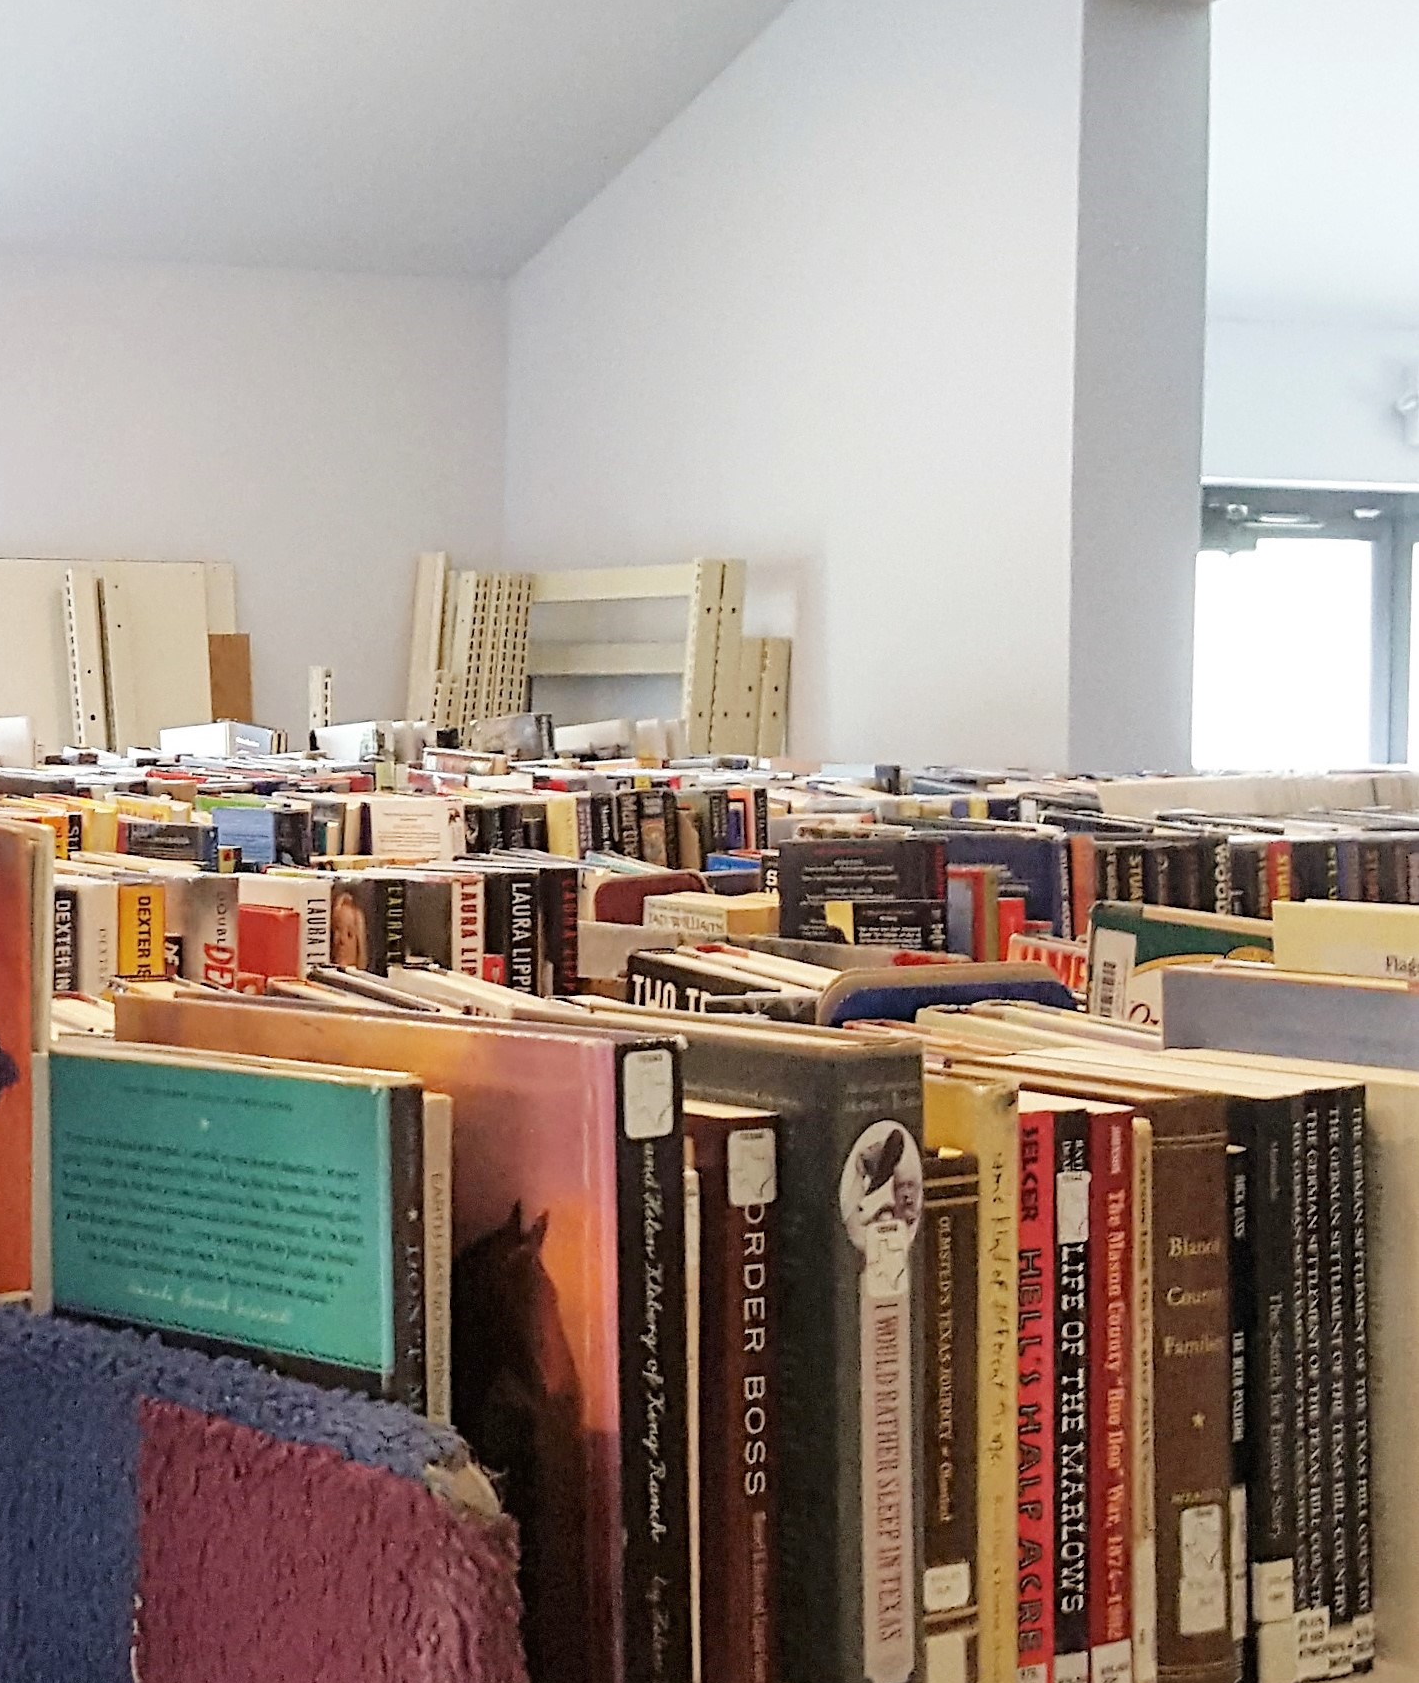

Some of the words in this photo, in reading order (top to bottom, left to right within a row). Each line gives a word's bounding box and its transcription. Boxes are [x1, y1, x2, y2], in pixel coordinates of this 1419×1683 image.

[1215, 843, 1232, 914] WOOD
[55, 899, 73, 973] DEXTER
[137, 895, 151, 959] DEXTER
[306, 898, 327, 946] LAURA
[385, 885, 404, 948] LAURA
[460, 881, 478, 948] LAURA
[511, 881, 532, 946] LAURA
[1306, 1108, 1318, 1144] THE
[1329, 1106, 1341, 1142] THE
[1352, 1105, 1364, 1141] THE
[1021, 1125, 1039, 1222] SELCER
[1307, 1147, 1319, 1230] GERMAN
[1330, 1145, 1342, 1227] GERMAN
[1353, 1144, 1365, 1225] GERMAN
[1108, 1188, 1127, 1228] The
[742, 1204, 765, 1354] ORDER
[1061, 1243, 1085, 1312] LIFE
[1107, 1230, 1126, 1299] Mason
[1307, 1233, 1320, 1351] SETTLEMENT
[1330, 1228, 1343, 1348] SETTLEMENT
[939, 1307, 954, 1363] TEXAS
[1018, 1247, 1043, 1384] HELL'S
[1061, 1320, 1086, 1357] OF
[1105, 1302, 1127, 1372] County
[1269, 1292, 1283, 1324] The
[640, 1358, 661, 1385] of
[875, 1316, 900, 1388] WOULD
[1309, 1353, 1321, 1379] OF
[1331, 1349, 1343, 1377] OF
[1355, 1346, 1367, 1373] OF
[645, 1386, 666, 1456] King
[939, 1365, 954, 1442] JOURNEY
[1061, 1368, 1086, 1434] THE
[1308, 1383, 1321, 1420] THE
[1331, 1381, 1344, 1418] THE
[1355, 1376, 1368, 1413] THE
[743, 1375, 766, 1497] BOSS
[876, 1390, 902, 1469] RATHER
[1018, 1404, 1043, 1521] HALF
[1309, 1424, 1322, 1482] TEXAS
[1332, 1421, 1345, 1478] TEXAS
[1356, 1417, 1368, 1476] TEXAS
[647, 1458, 668, 1544] Ranch
[877, 1472, 903, 1540] SLEEP
[1060, 1443, 1086, 1616] MARLOWS
[1310, 1485, 1322, 1527] HILL
[1332, 1481, 1345, 1526] HILL
[1356, 1478, 1369, 1523] HILL
[879, 1546, 902, 1571] IN
[1332, 1527, 1346, 1618] COUNTRY
[879, 1574, 903, 1644] TEXAS
[1018, 1537, 1043, 1653] ACRE
